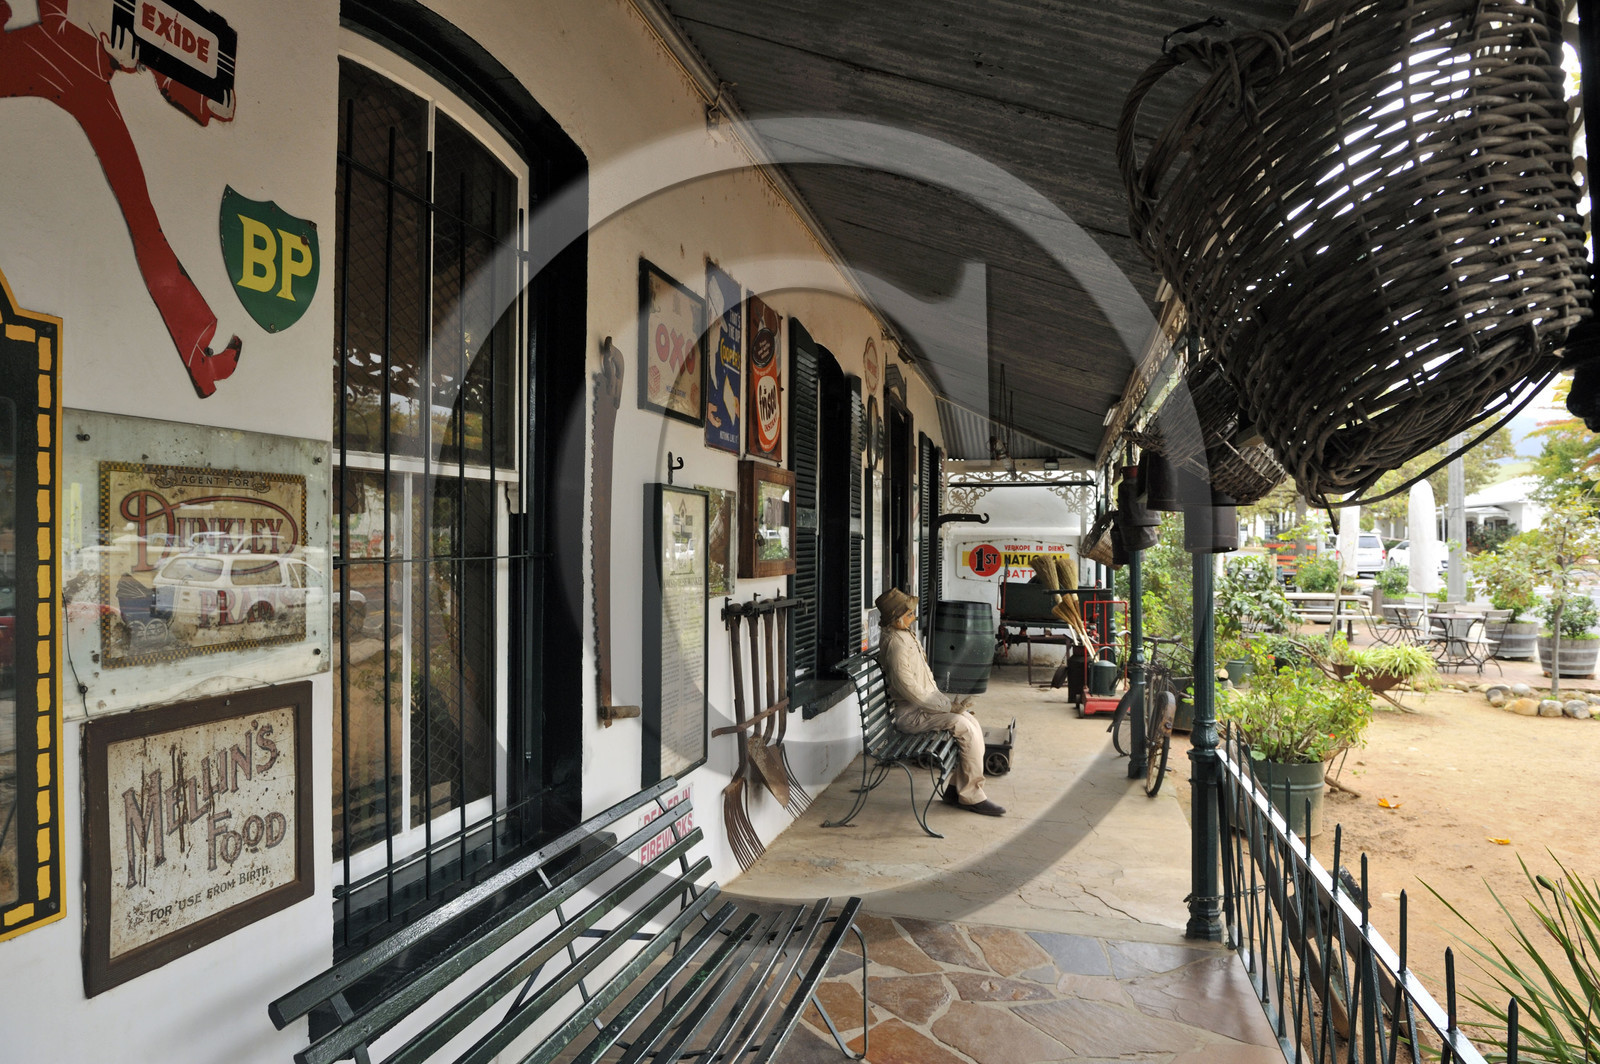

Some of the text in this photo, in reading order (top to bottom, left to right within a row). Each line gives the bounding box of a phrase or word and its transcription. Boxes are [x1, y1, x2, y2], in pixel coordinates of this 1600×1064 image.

[141, 1, 211, 64] EXIDE
[236, 213, 314, 302] BP
[655, 322, 696, 376] OXO
[758, 383, 777, 423] frisco
[181, 474, 250, 488] AGENT FOR
[120, 489, 299, 574] DUNKLEY
[1004, 544, 1031, 552] VERKOPE
[1047, 544, 1065, 552] DIENS
[974, 547, 998, 572] 1ST
[121, 719, 280, 891] MELLIN'S
[207, 808, 287, 873] FOOD
[150, 904, 172, 923] FOR
[178, 892, 202, 911] USE
[206, 878, 236, 900] FROM
